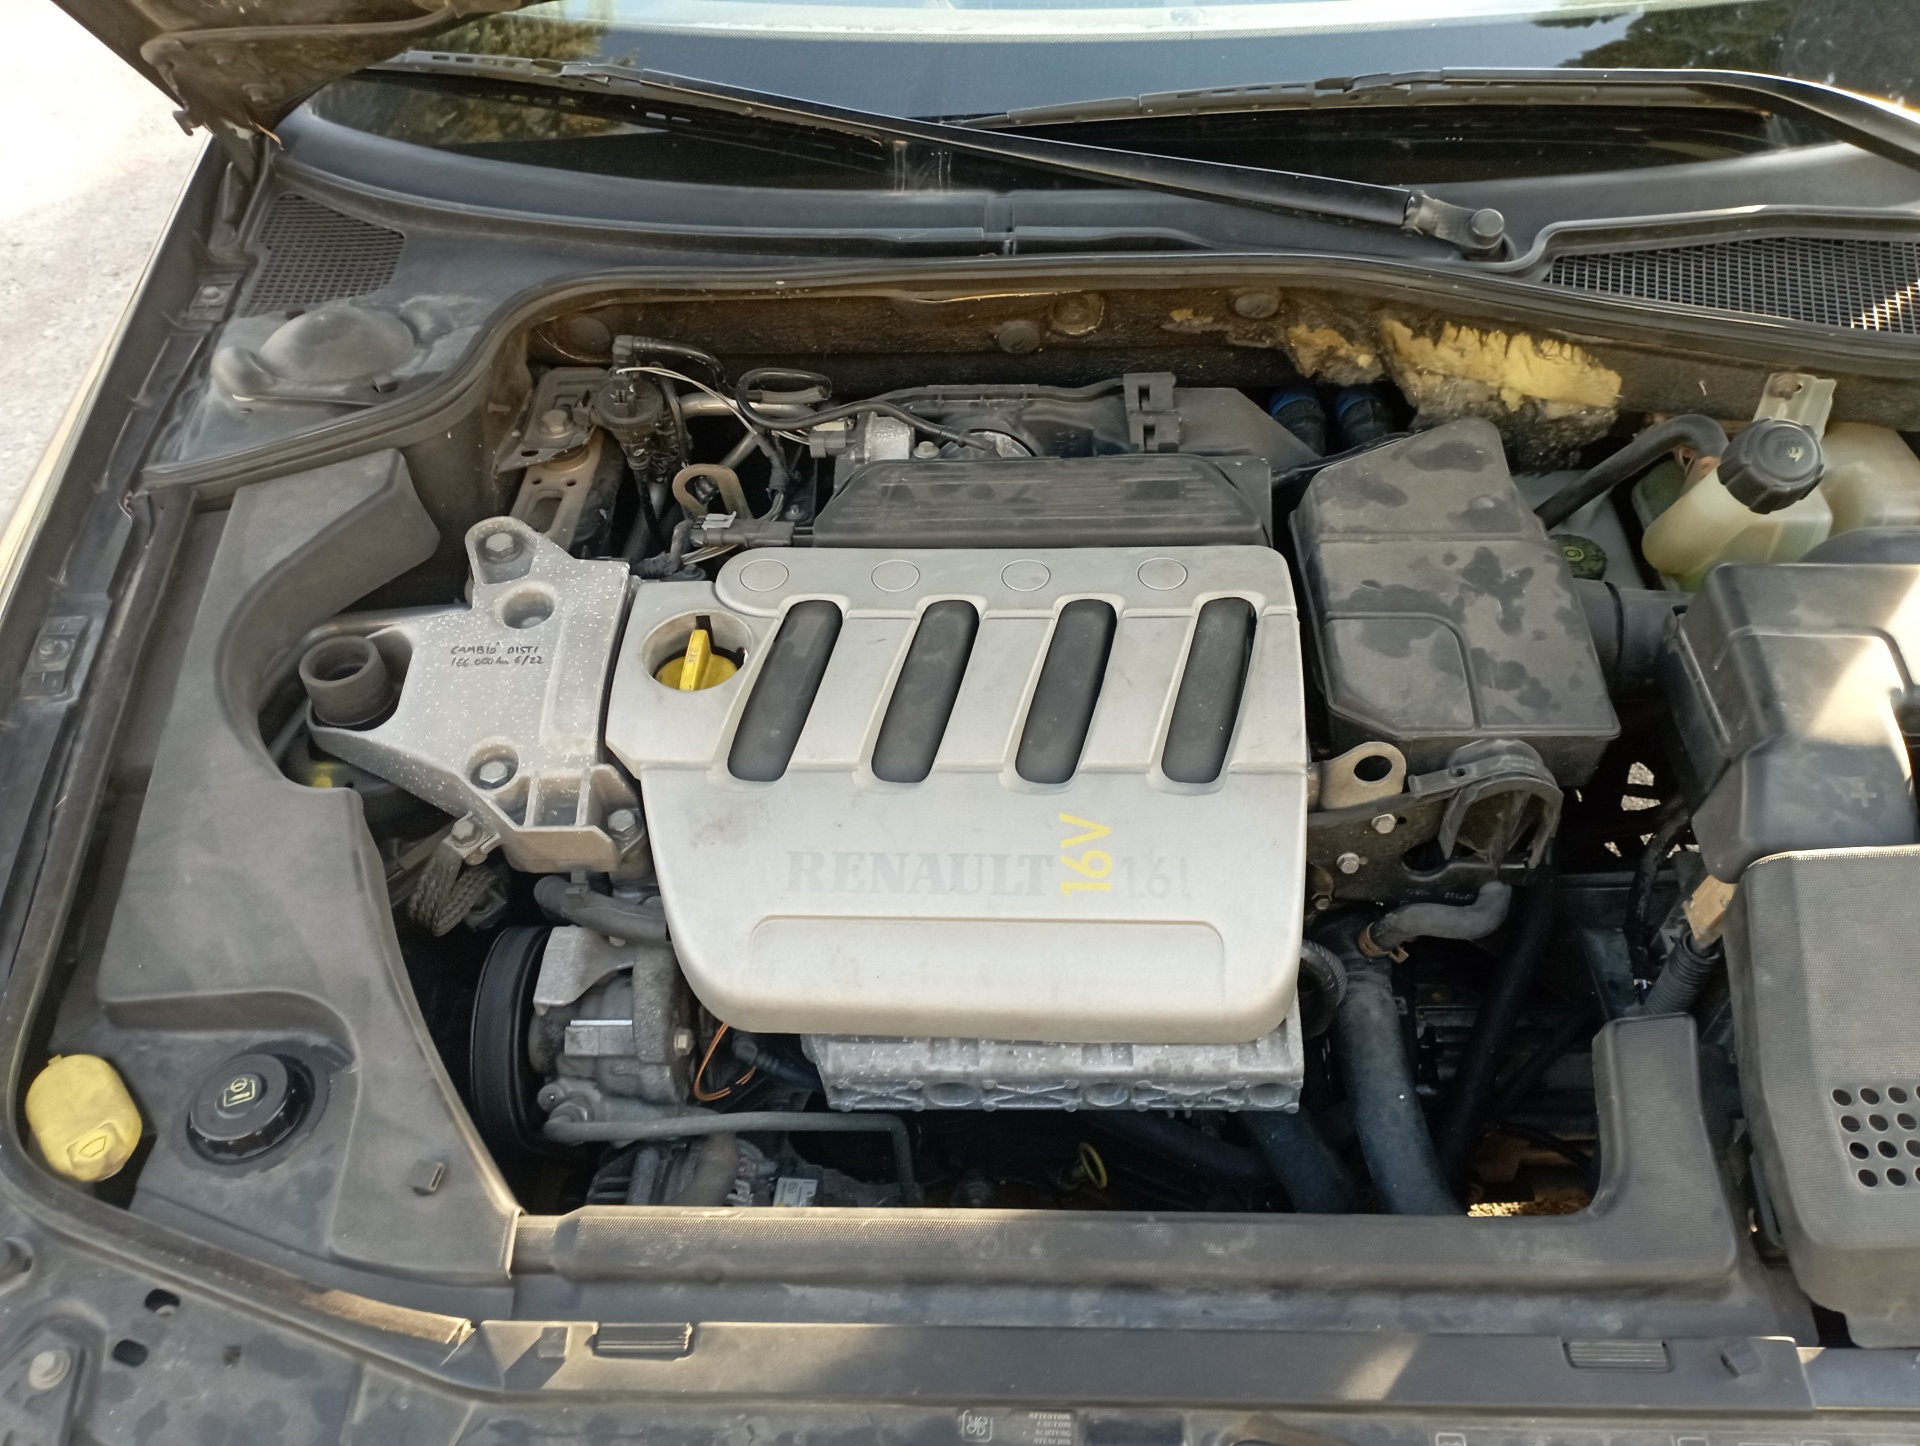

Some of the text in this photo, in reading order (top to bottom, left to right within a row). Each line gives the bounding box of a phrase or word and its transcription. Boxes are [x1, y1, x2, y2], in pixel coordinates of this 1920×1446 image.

[514, 655, 545, 666] 6/22
[786, 850, 1054, 896] RENAULT
[1059, 812, 1112, 896] 16V
